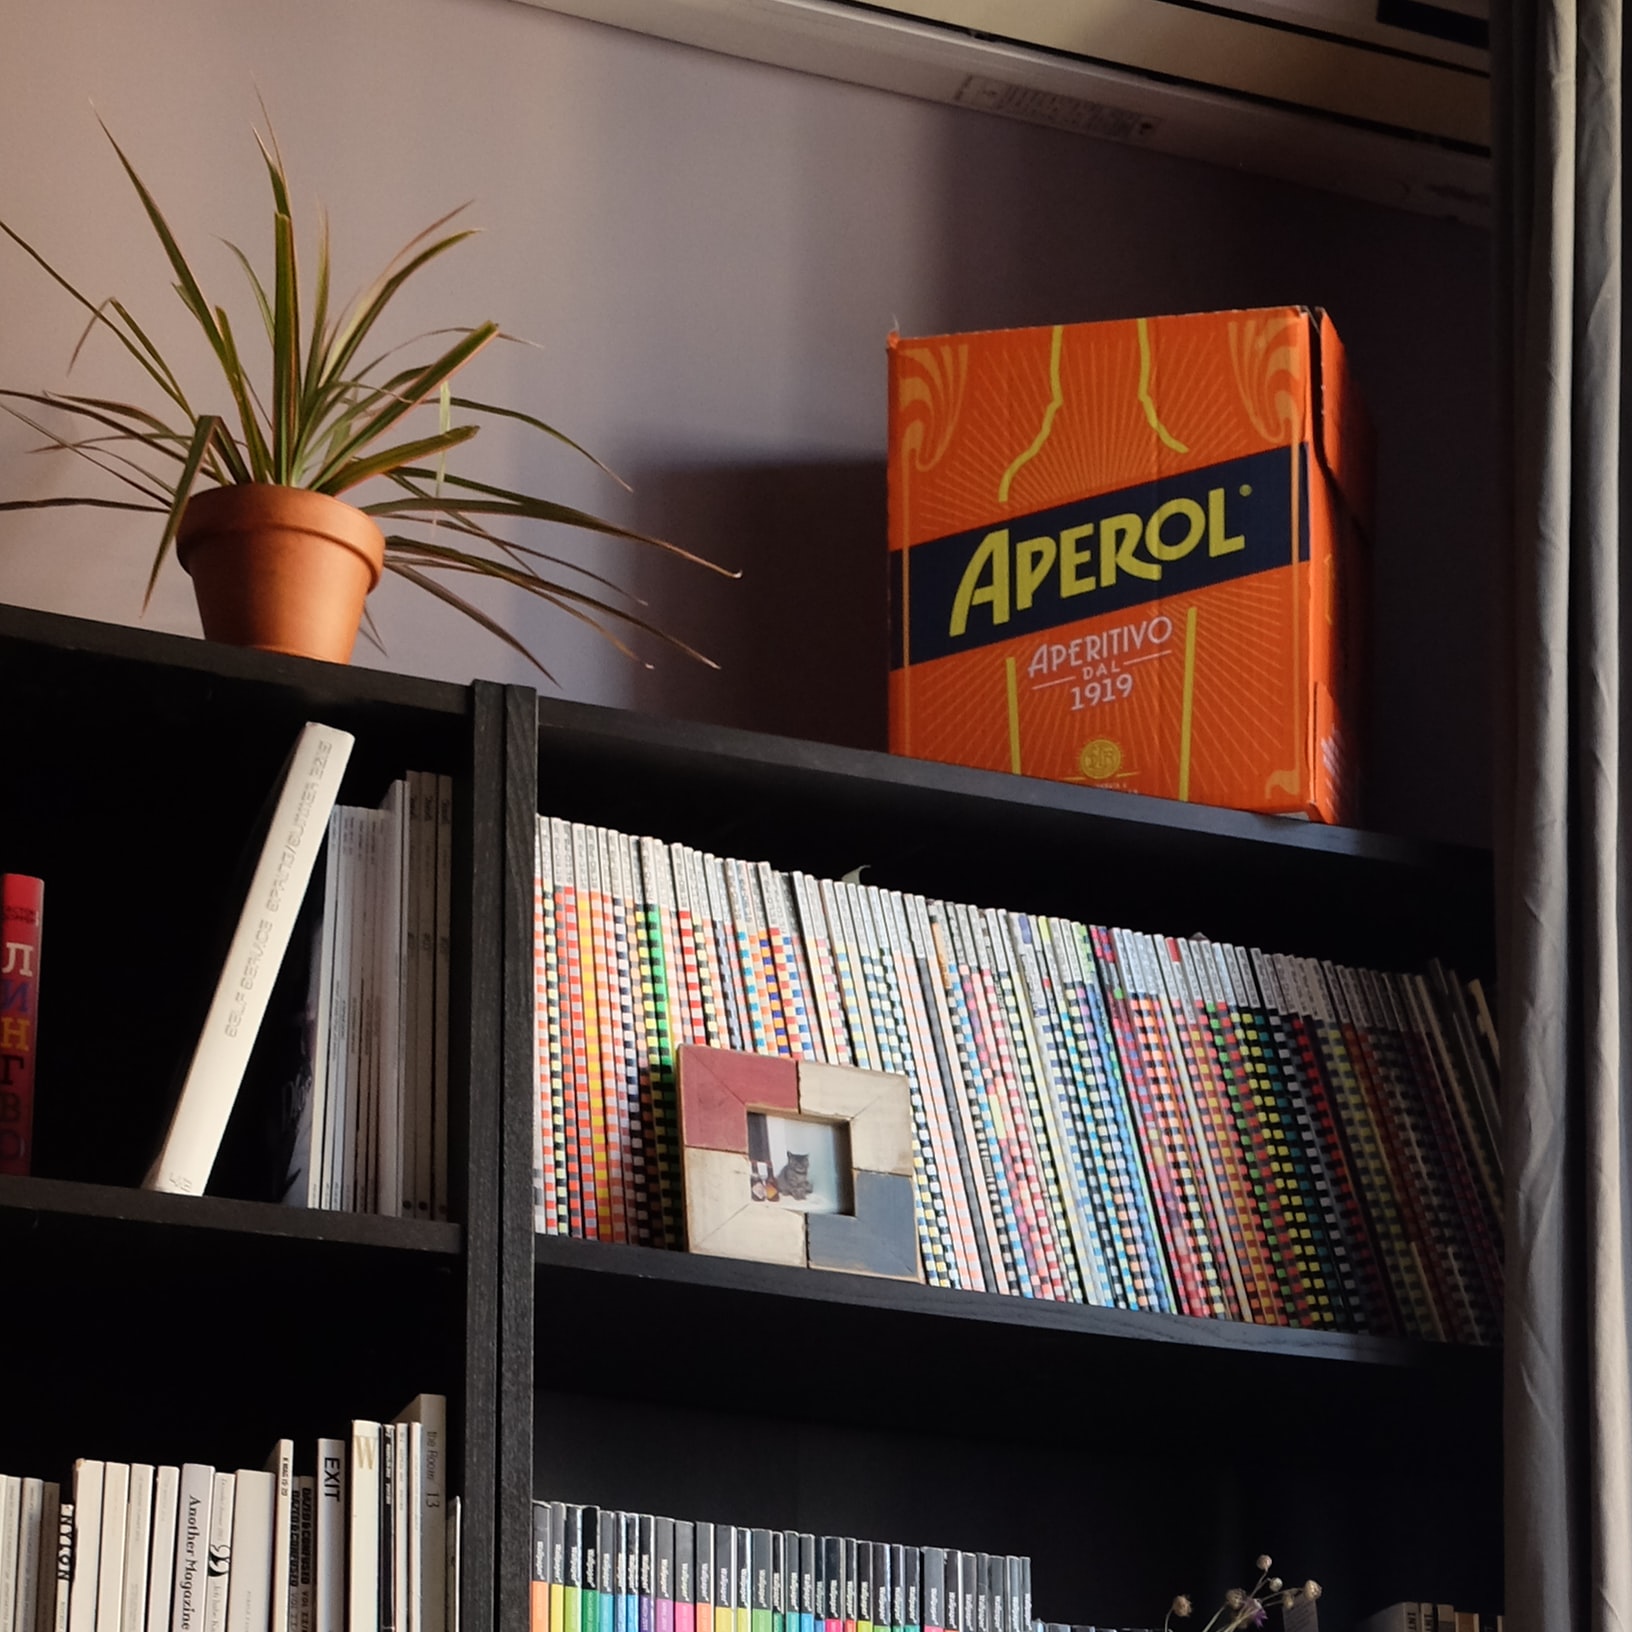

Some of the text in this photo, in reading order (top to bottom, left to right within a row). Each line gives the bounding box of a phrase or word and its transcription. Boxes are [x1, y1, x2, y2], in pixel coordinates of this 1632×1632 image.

[949, 487, 1246, 638] APEROL
[1027, 615, 1174, 679] APERITIVO
[1082, 661, 1121, 681] DAL
[1070, 672, 1134, 711] 1919
[324, 1457, 341, 1502] EXIT
[355, 1436, 378, 1469] W
[425, 1431, 440, 1508] the Room 13
[57, 1514, 72, 1581] NYLON
[184, 1494, 201, 1557] Another
[180, 1559, 198, 1631] Magazine
